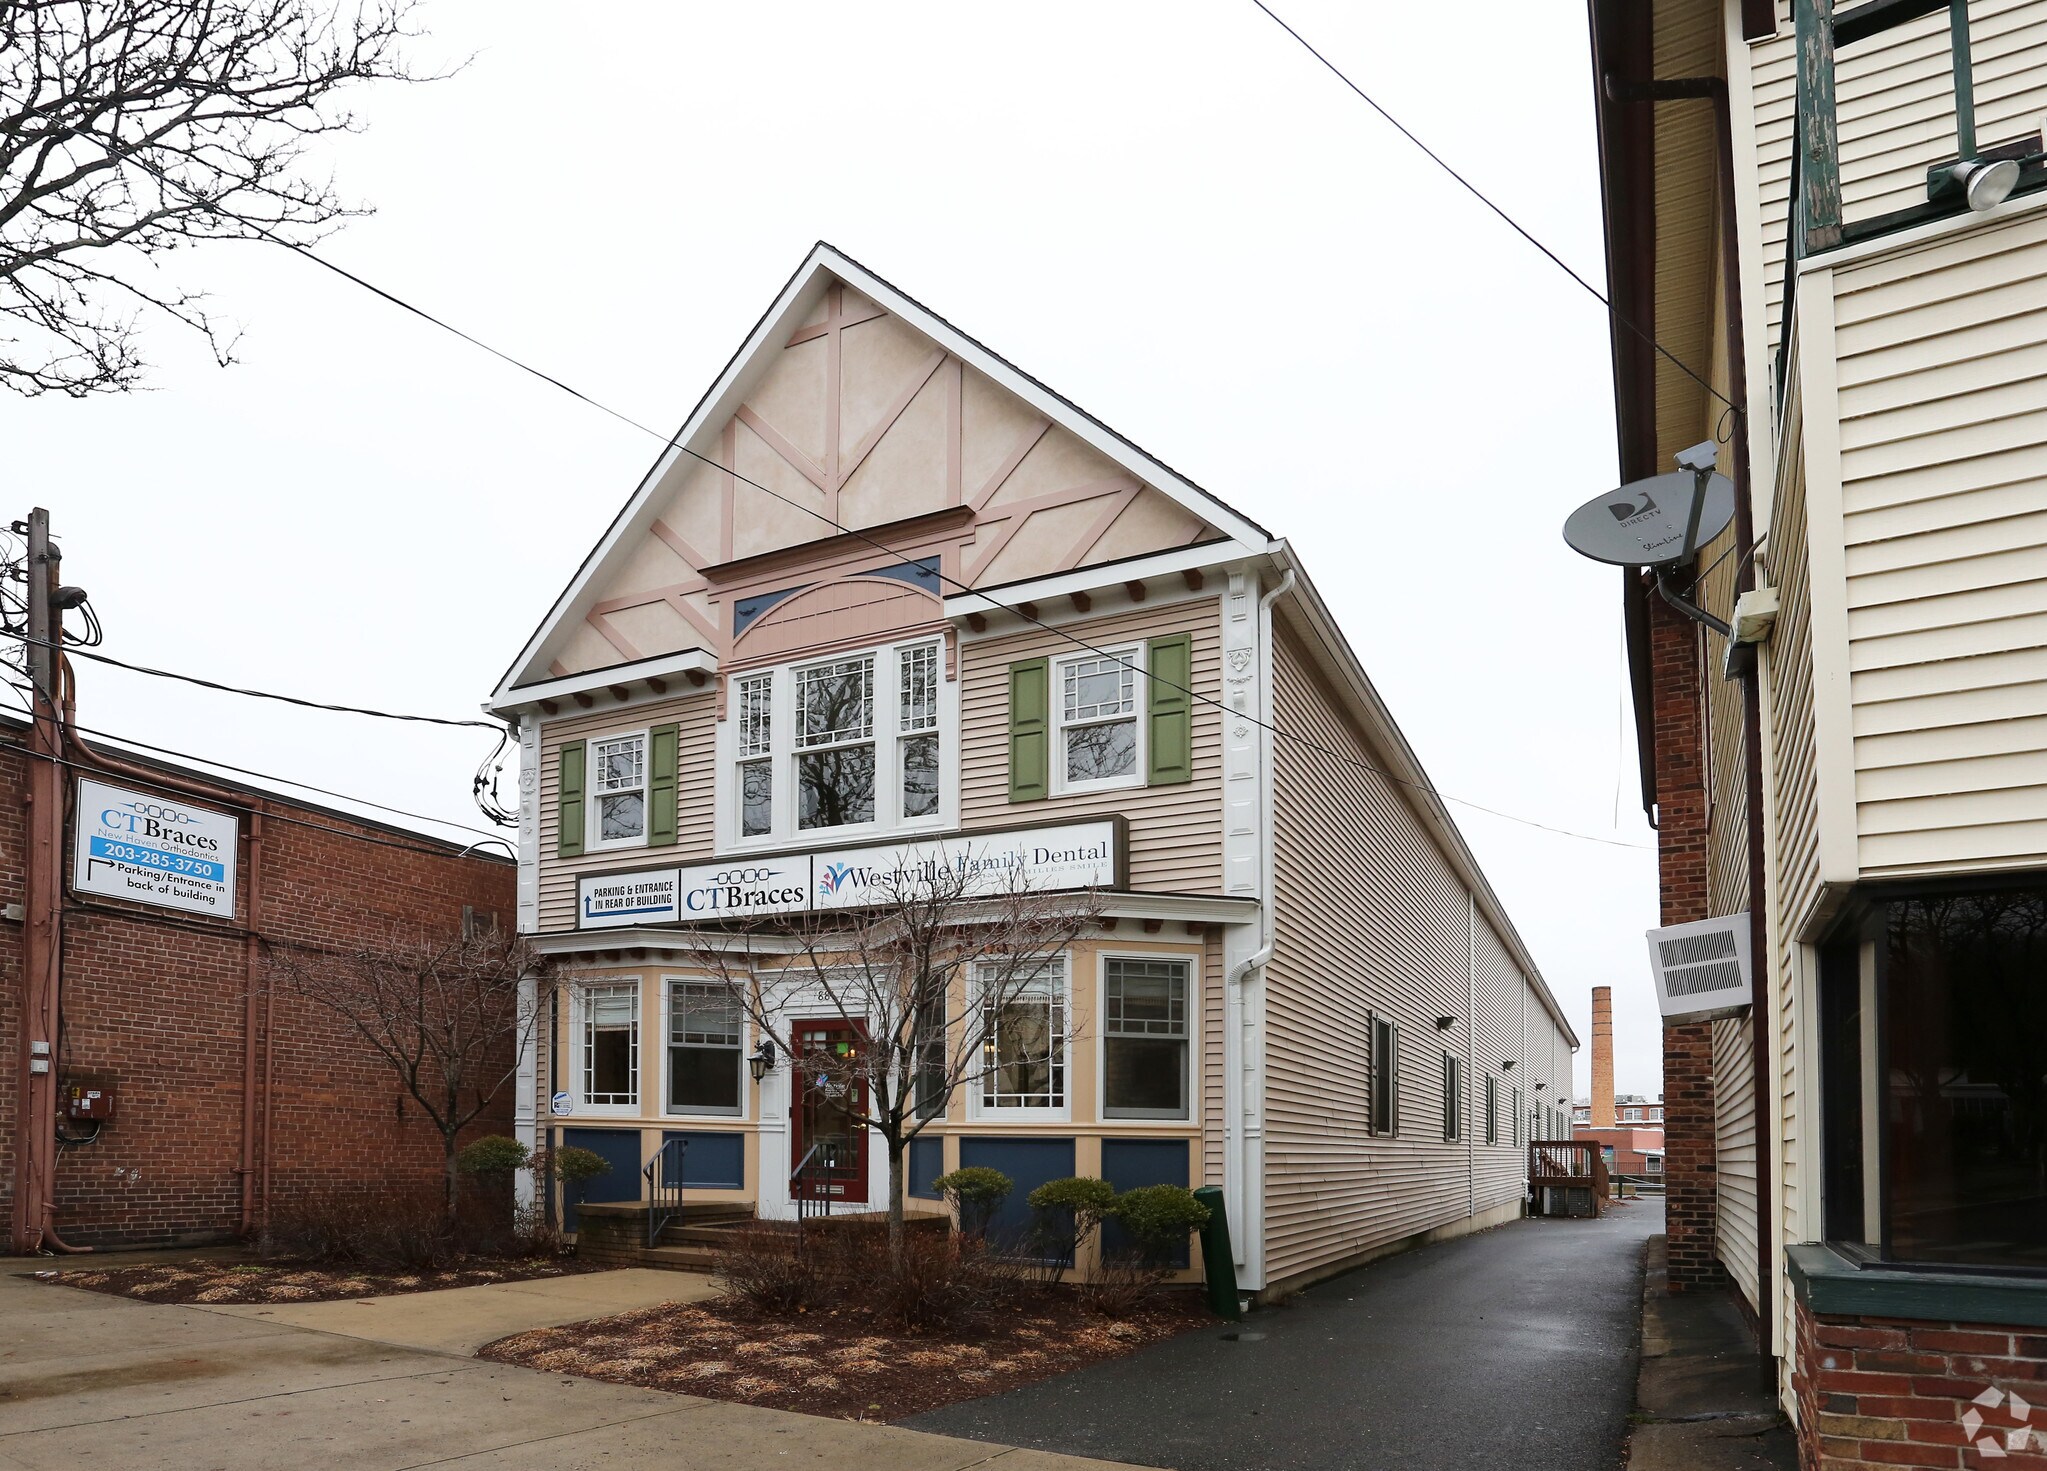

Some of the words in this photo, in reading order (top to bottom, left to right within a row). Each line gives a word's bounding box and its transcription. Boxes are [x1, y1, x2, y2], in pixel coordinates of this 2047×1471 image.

[1620, 509, 1662, 528] DIRECTV
[98, 828, 122, 840] New
[126, 834, 158, 849] Haven
[160, 842, 219, 862] Orthodontics
[104, 843, 212, 876] 203-285-3750
[850, 860, 951, 888] Westville
[956, 851, 1027, 873] Family
[1033, 841, 1108, 865] Dental
[1070, 862, 1108, 870] SMILE
[117, 862, 212, 890] Parking/Entrance
[215, 883, 225, 893] in
[594, 885, 625, 898] PARKING
[627, 885, 633, 895] &
[635, 881, 673, 895] ENTRANCE
[127, 878, 154, 891] back
[158, 885, 170, 894] of
[173, 886, 216, 905] building
[595, 899, 603, 910] IN
[605, 897, 624, 909] REAR
[625, 897, 635, 907] OF
[637, 893, 672, 906] BUILDING
